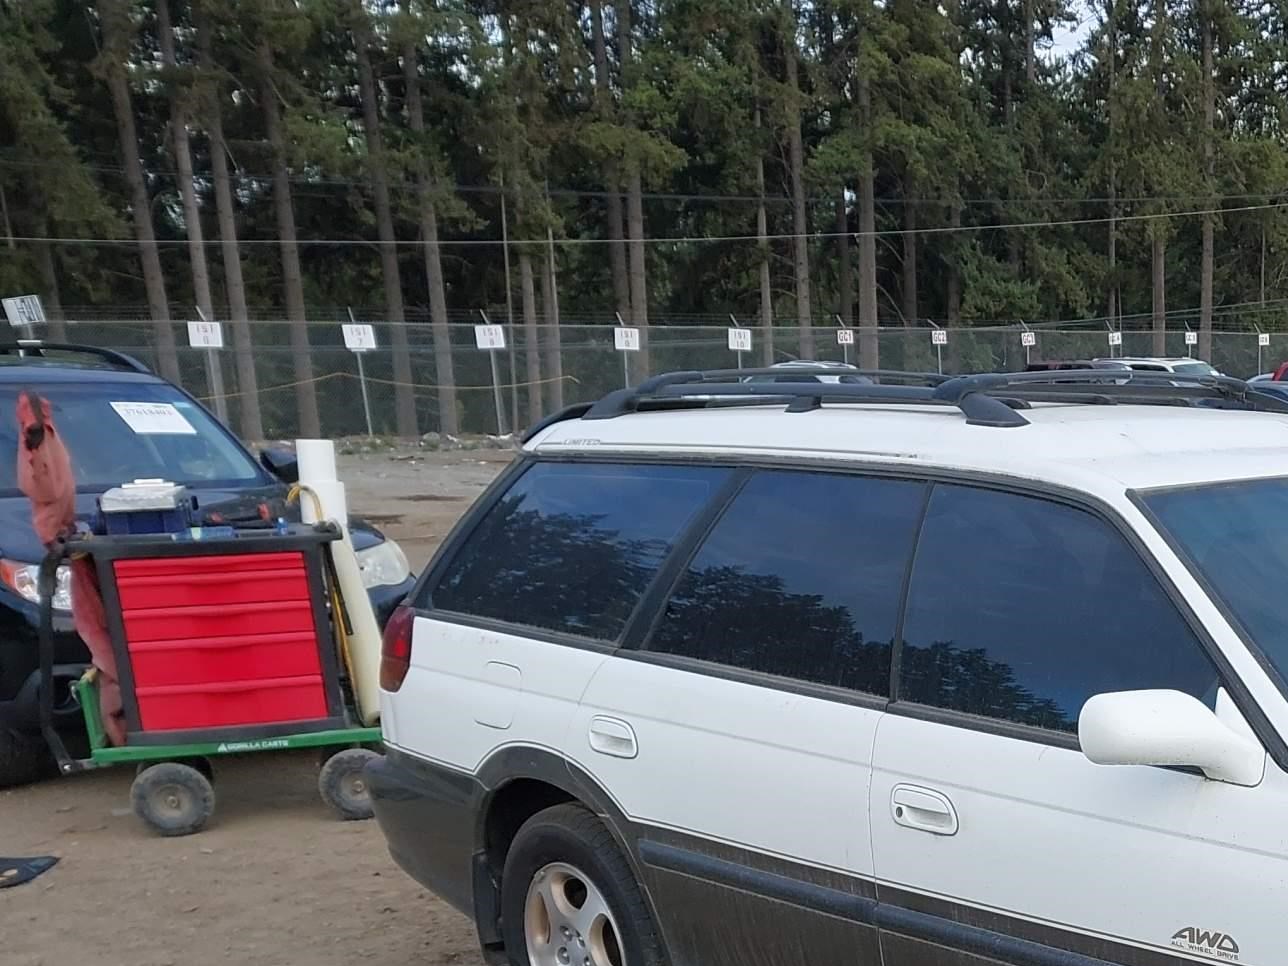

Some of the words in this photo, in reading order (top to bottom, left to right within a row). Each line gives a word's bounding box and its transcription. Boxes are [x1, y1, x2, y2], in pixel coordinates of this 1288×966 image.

[1171, 926, 1240, 953] AWD
[1188, 944, 1214, 955] WHEEL
[1216, 950, 1240, 961] DRIVE
